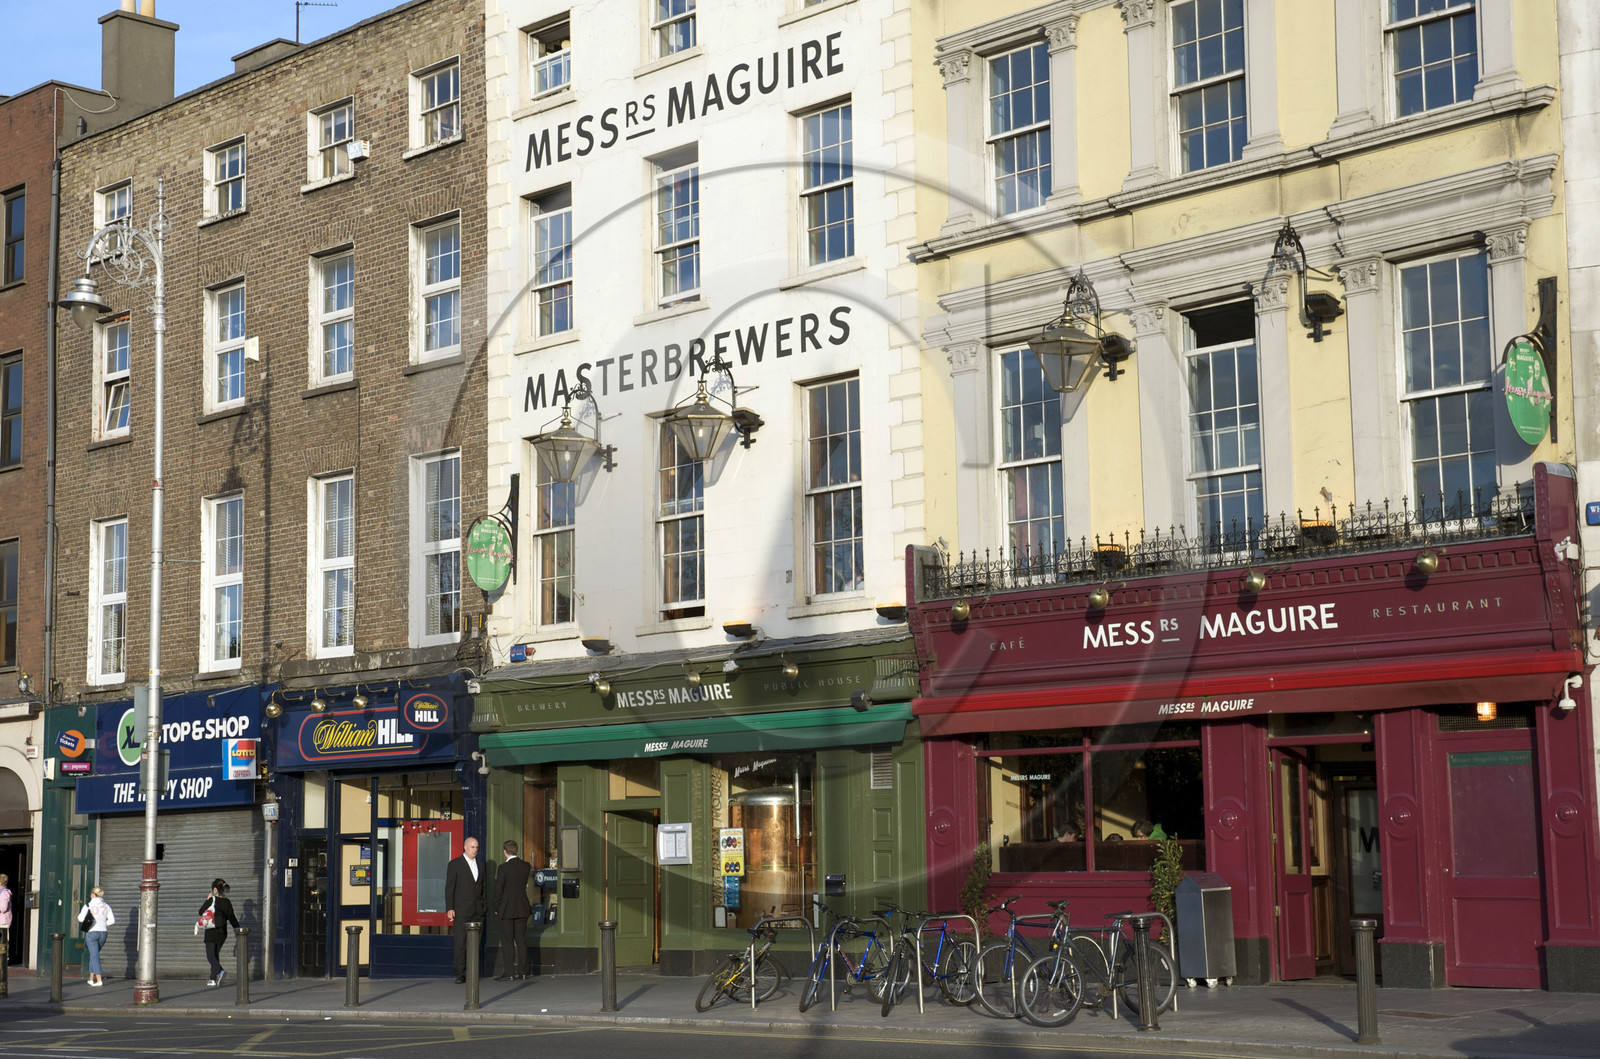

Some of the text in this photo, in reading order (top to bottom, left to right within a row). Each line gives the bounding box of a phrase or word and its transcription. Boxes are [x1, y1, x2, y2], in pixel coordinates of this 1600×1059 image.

[667, 31, 845, 128] MAGUIRE
[523, 306, 851, 413] MASTERBREWERS
[989, 636, 1025, 651] CAFÉ
[1199, 603, 1339, 639] MAGUIRE
[1372, 597, 1503, 618] RESTAURANT
[517, 701, 567, 712] BREWERY
[668, 683, 733, 704] MAGUIRE
[763, 681, 810, 692] PUBLIC
[818, 675, 862, 687] HOUSE
[1200, 699, 1255, 713] MAGUIRE
[146, 715, 250, 747] TOP&SHOP
[414, 710, 439, 723] HILL
[313, 719, 378, 753] William
[670, 739, 709, 750] MAGUIRE
[231, 749, 255, 758] LOTTO
[113, 782, 136, 803] THE
[178, 776, 213, 800] SHOP
